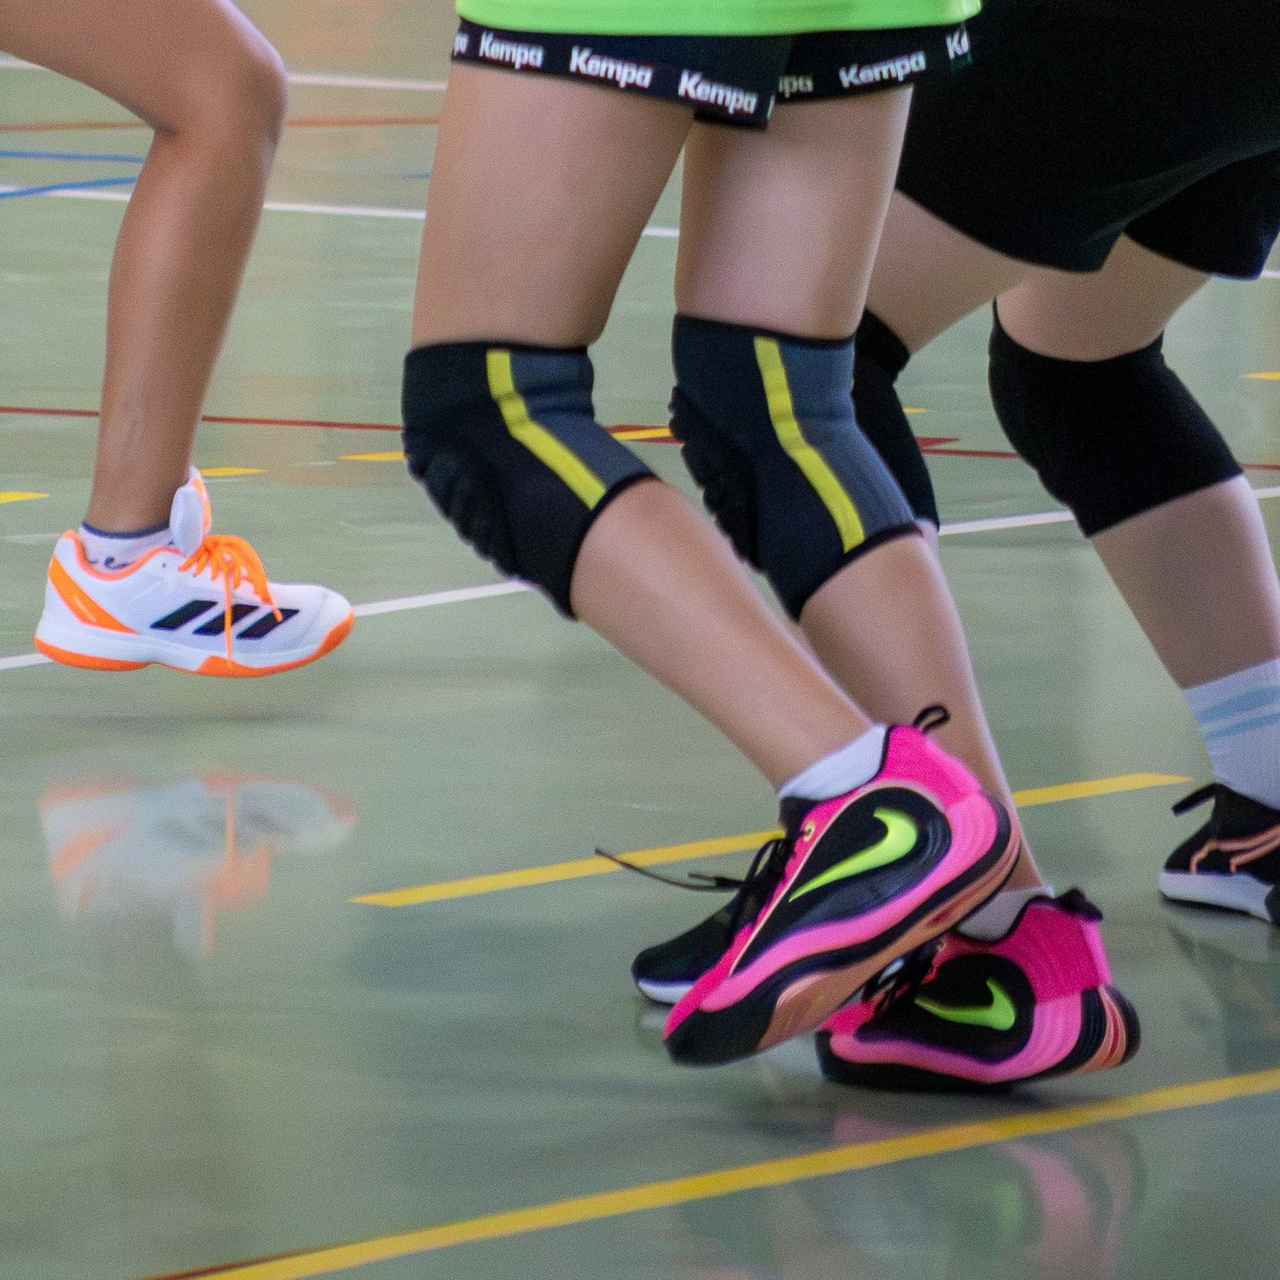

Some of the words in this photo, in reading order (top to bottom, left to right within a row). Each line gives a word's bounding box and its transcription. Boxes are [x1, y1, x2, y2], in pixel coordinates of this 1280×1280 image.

[478, 31, 544, 70] Kempa
[570, 45, 654, 88] Kempa
[678, 68, 758, 115] Kempa
[838, 50, 927, 88] Kempa
